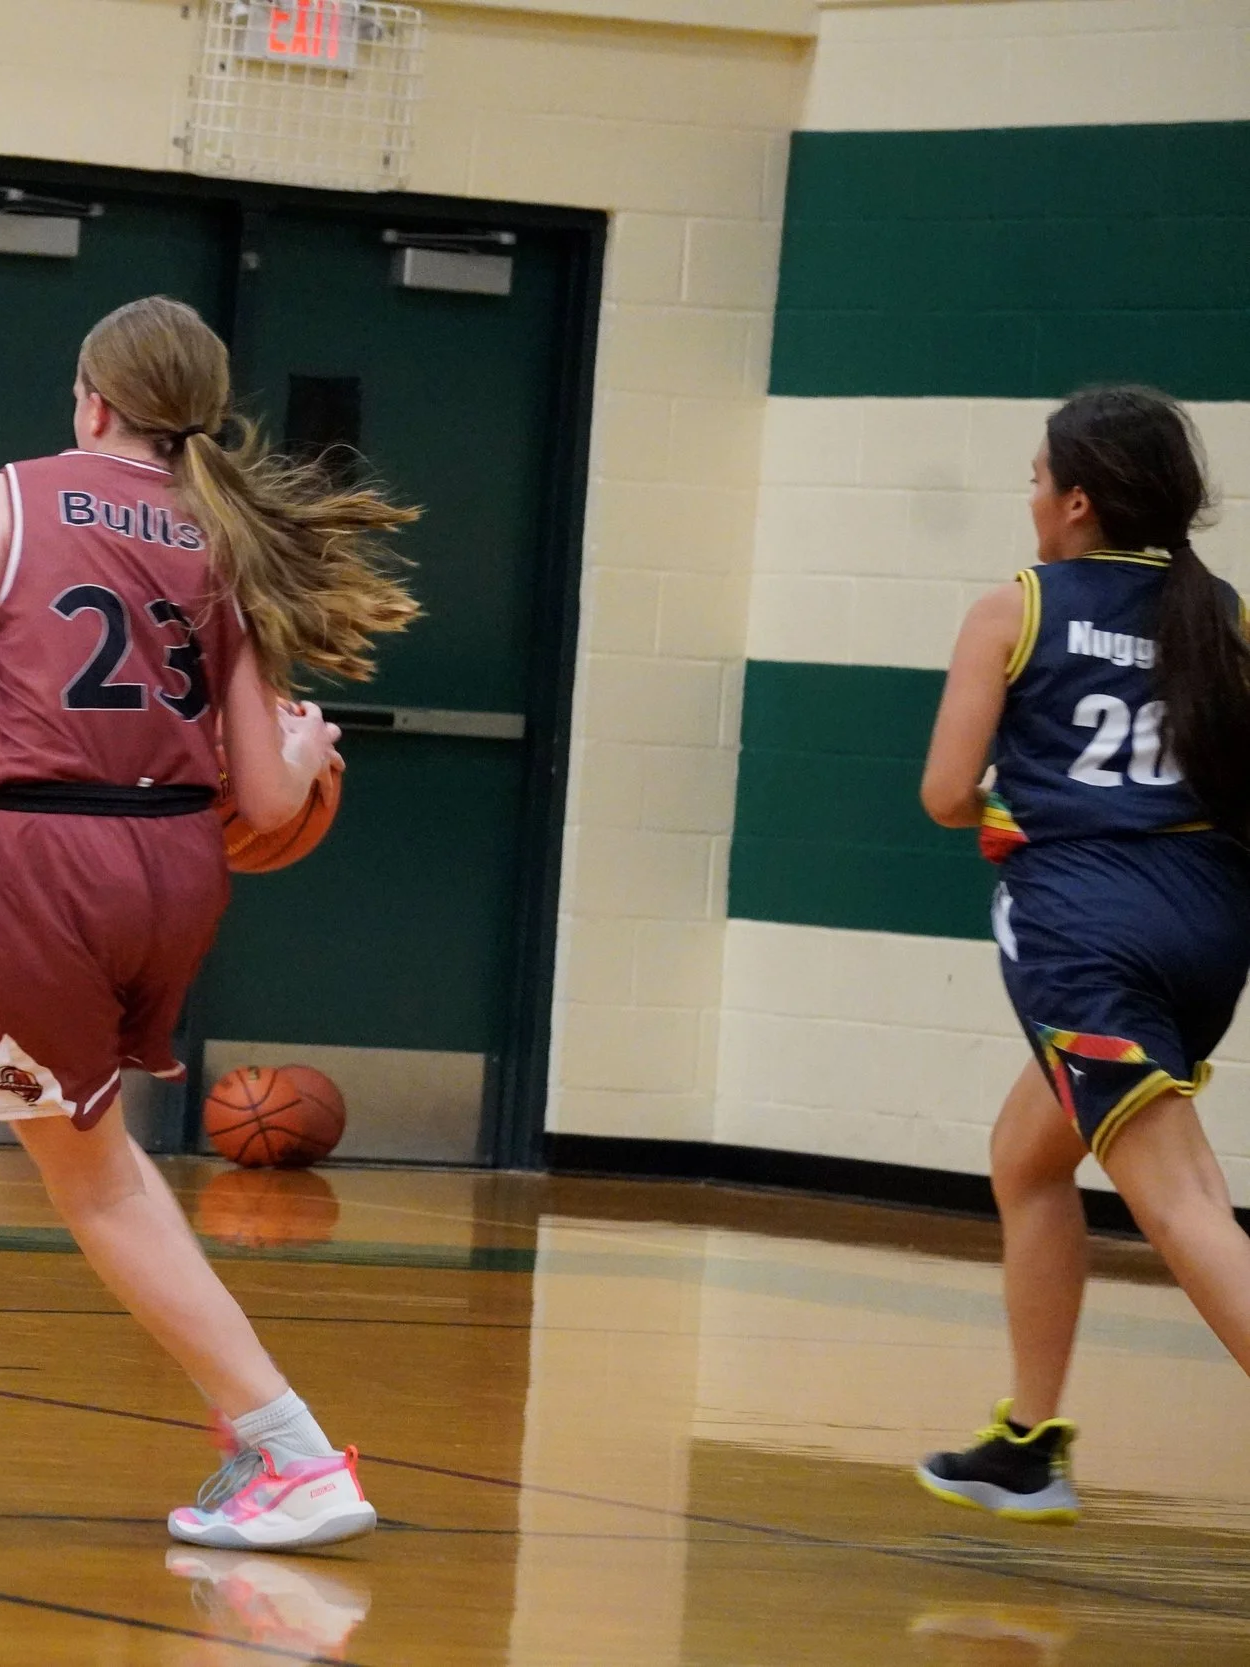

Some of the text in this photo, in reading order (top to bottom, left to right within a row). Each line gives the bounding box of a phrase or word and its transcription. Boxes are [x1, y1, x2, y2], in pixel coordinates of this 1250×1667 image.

[58, 491, 206, 550] Bulls
[49, 583, 210, 722] 23
[1067, 620, 1158, 669] Nugg
